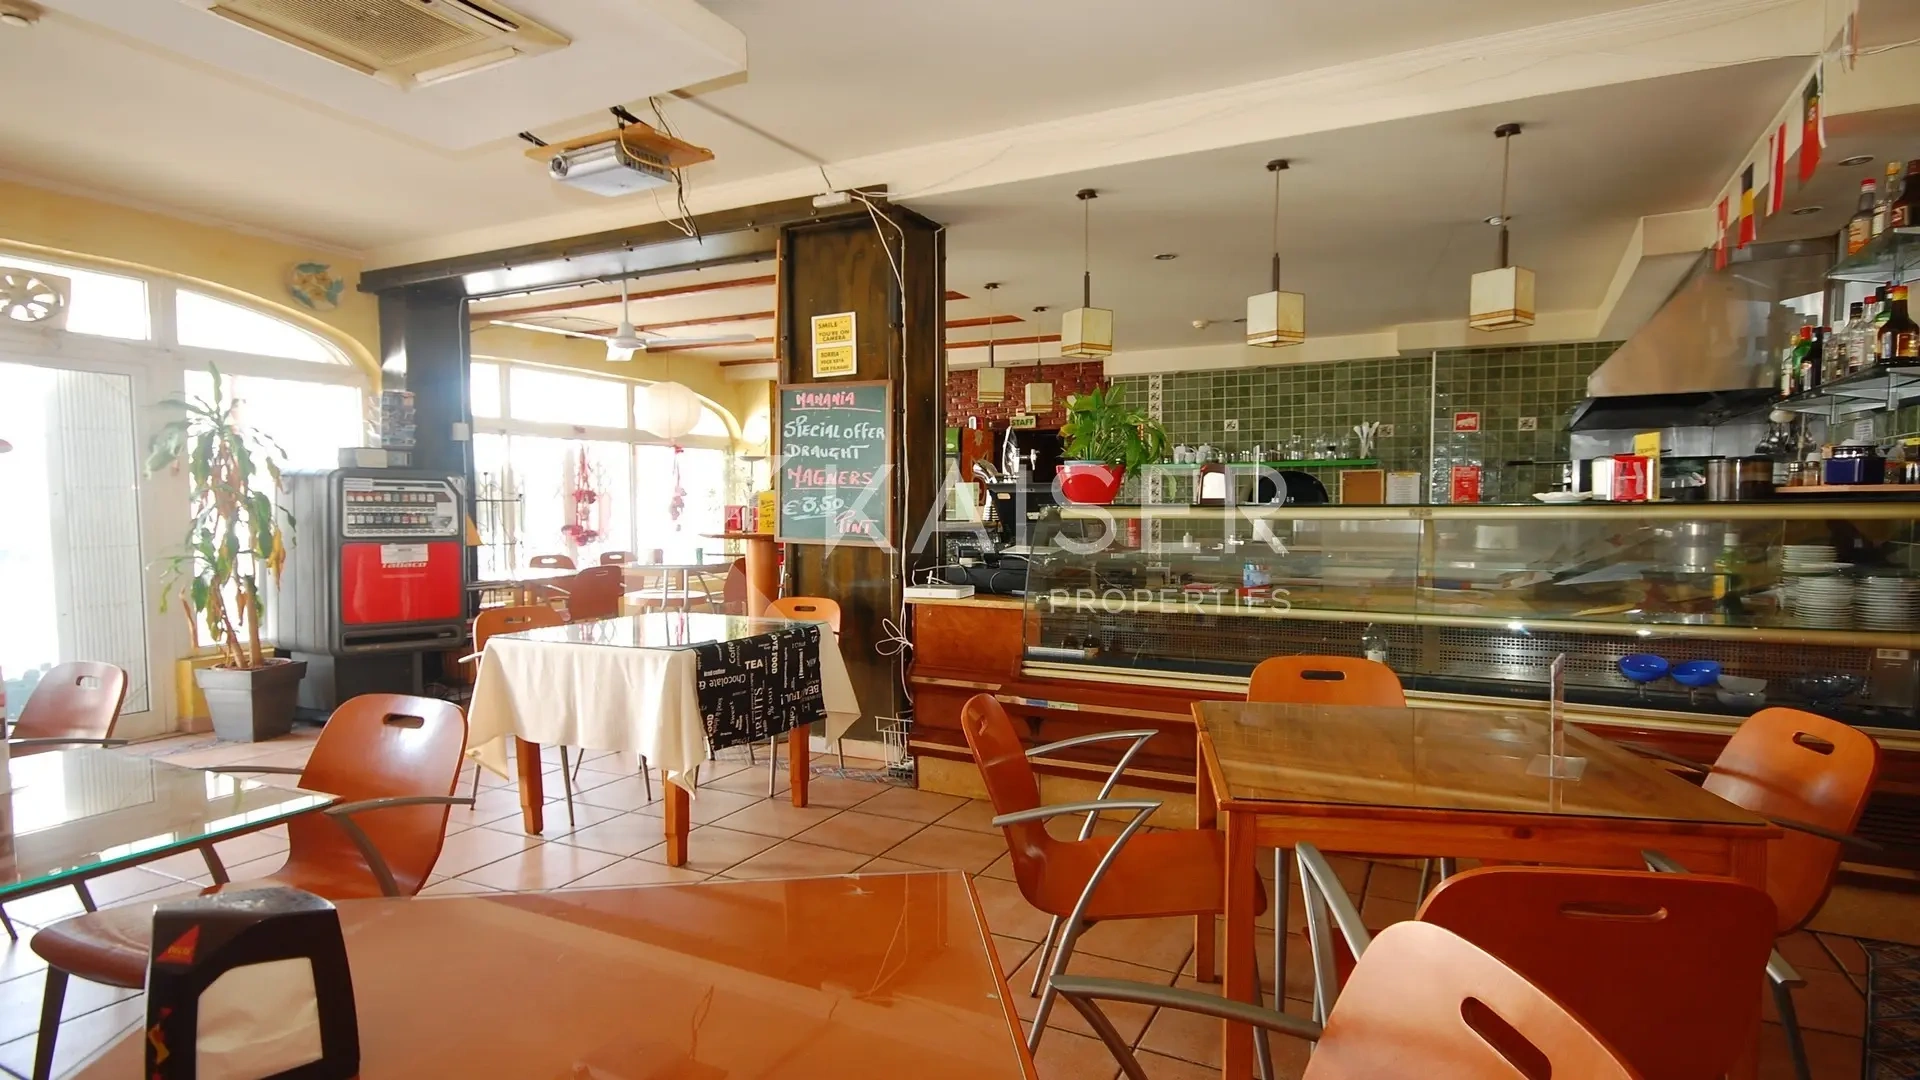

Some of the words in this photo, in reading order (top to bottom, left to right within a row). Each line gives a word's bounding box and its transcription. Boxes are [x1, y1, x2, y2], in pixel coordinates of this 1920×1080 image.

[818, 321, 838, 329] SMILE
[783, 415, 841, 438] SPECIAL
[783, 443, 870, 460] DRAUGHT
[787, 464, 873, 488] MAGNERS
[833, 508, 879, 535] PINT
[744, 658, 763, 670] TEA
[708, 673, 747, 688] Chocolate
[754, 687, 764, 738] FRUITS
